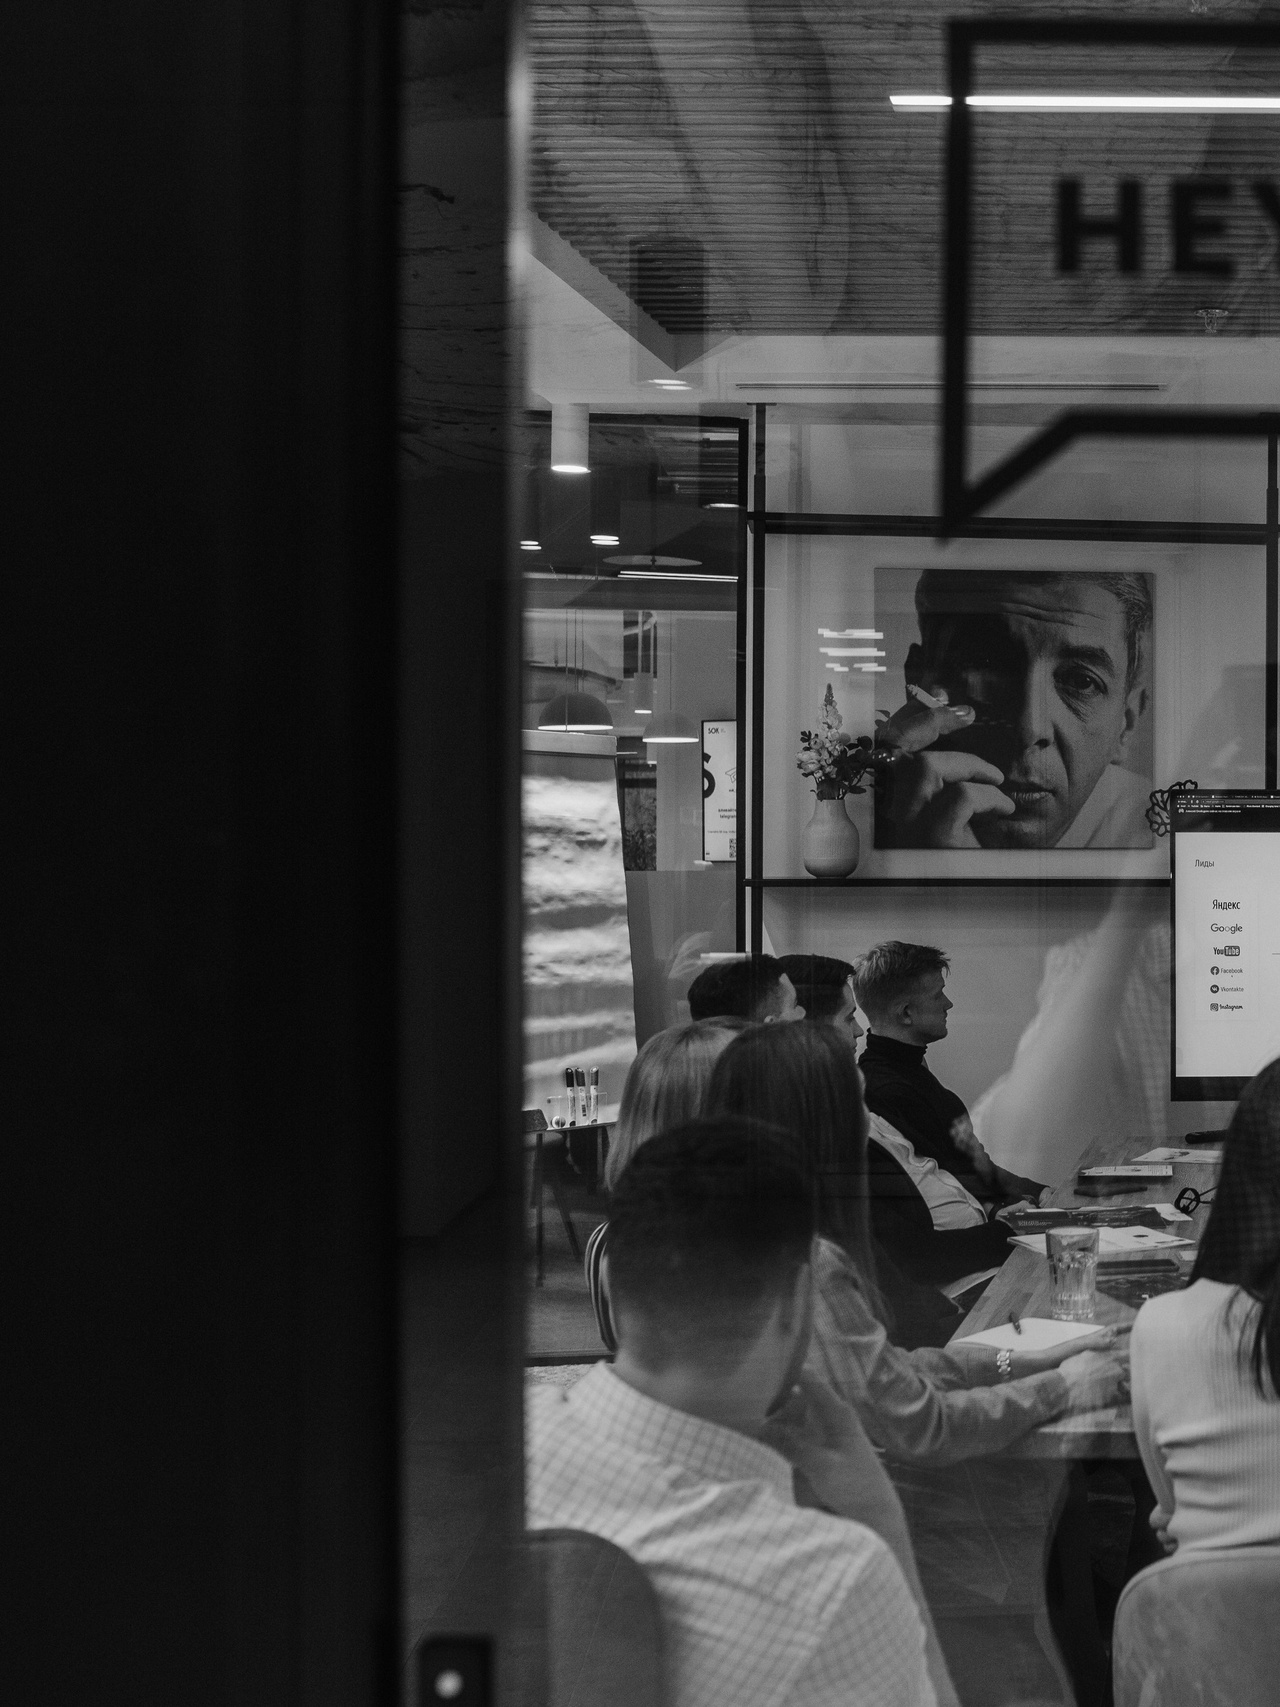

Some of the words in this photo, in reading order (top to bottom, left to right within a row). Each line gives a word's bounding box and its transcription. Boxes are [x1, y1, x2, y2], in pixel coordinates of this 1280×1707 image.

[1194, 858, 1215, 868] Лиды
[1212, 899, 1241, 911] Яндекс
[1210, 923, 1243, 935] Google
[1213, 945, 1240, 957] YouTube
[1219, 1003, 1244, 1012] Instagram
